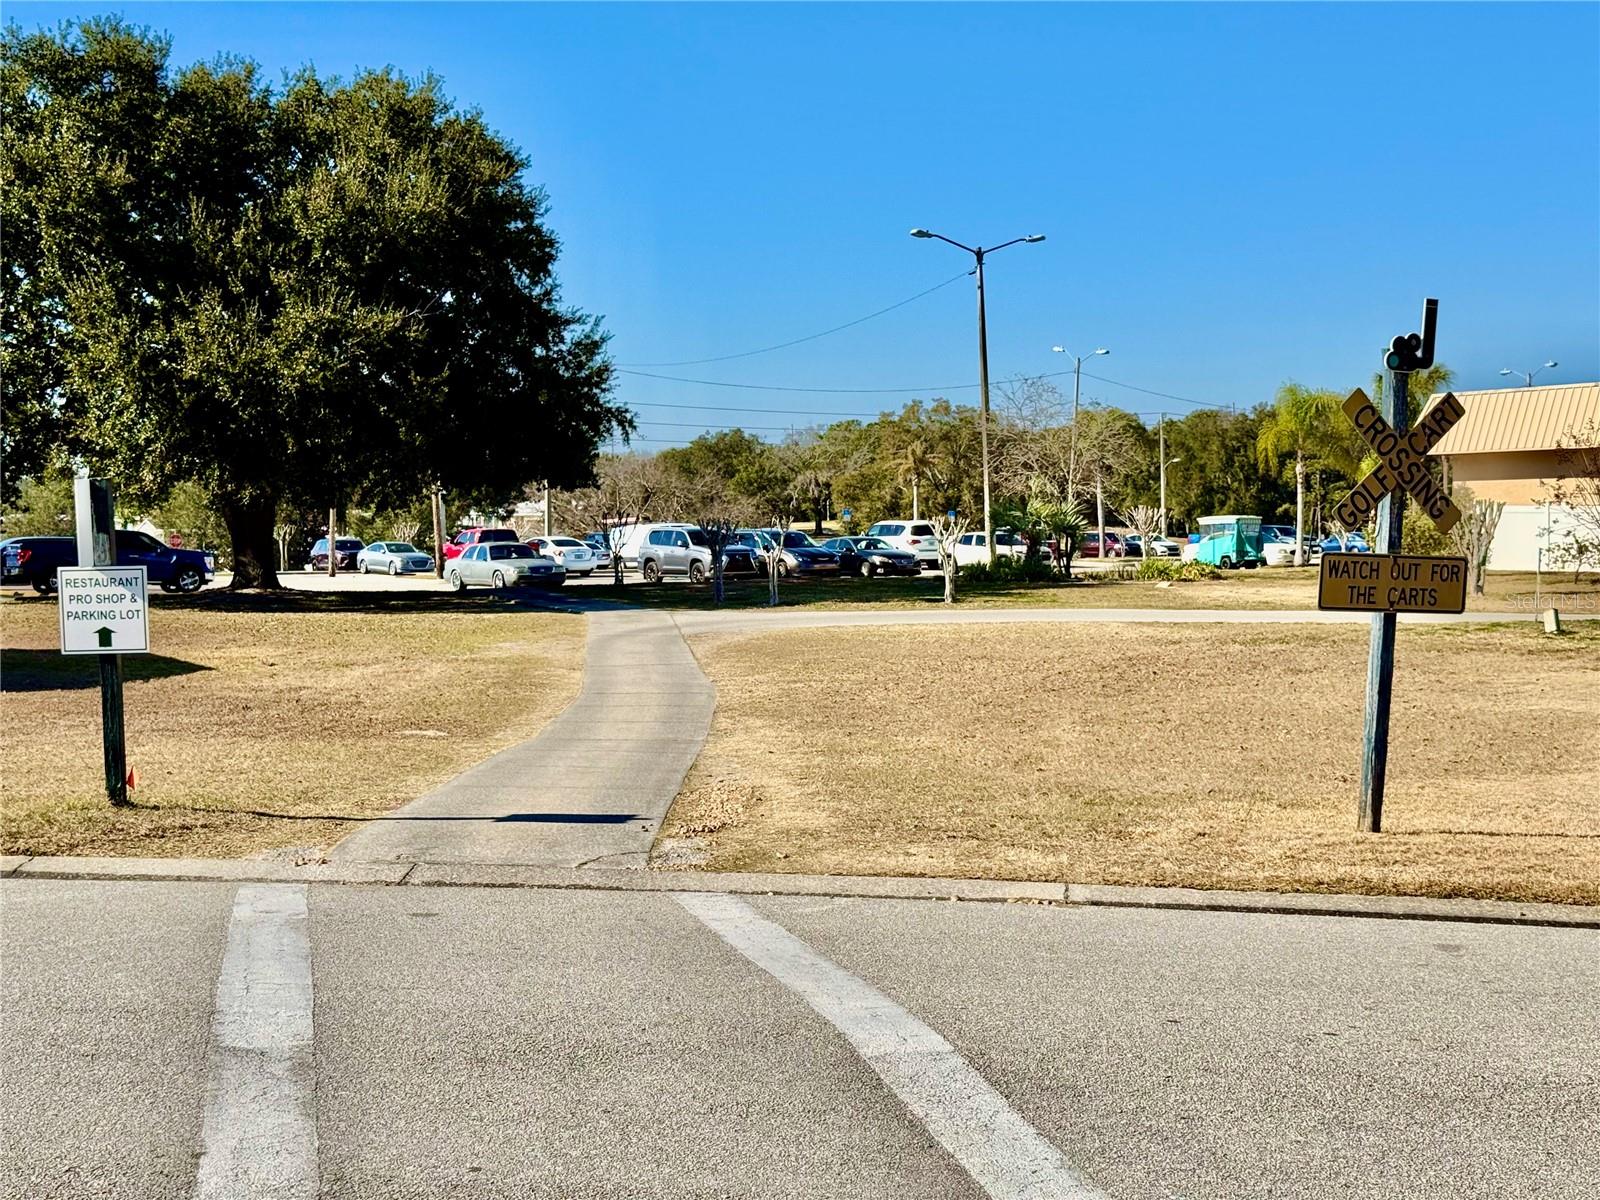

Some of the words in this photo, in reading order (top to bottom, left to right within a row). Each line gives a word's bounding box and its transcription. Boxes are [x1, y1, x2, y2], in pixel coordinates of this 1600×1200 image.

[1337, 464, 1393, 530] GOLF
[1407, 395, 1462, 457] CART
[1354, 404, 1450, 520] CROSSING
[65, 576, 140, 588] RESTAURANT
[1328, 559, 1380, 580] WATCH
[1390, 562, 1421, 581] OUT
[1430, 563, 1460, 583] FOR
[69, 594, 93, 605] PRO
[95, 593, 127, 604] SHOP
[130, 592, 138, 604] &
[1348, 585, 1377, 605] THE
[1387, 586, 1438, 607] CARTS
[67, 610, 117, 621] PARKING
[119, 609, 141, 620] LOT
